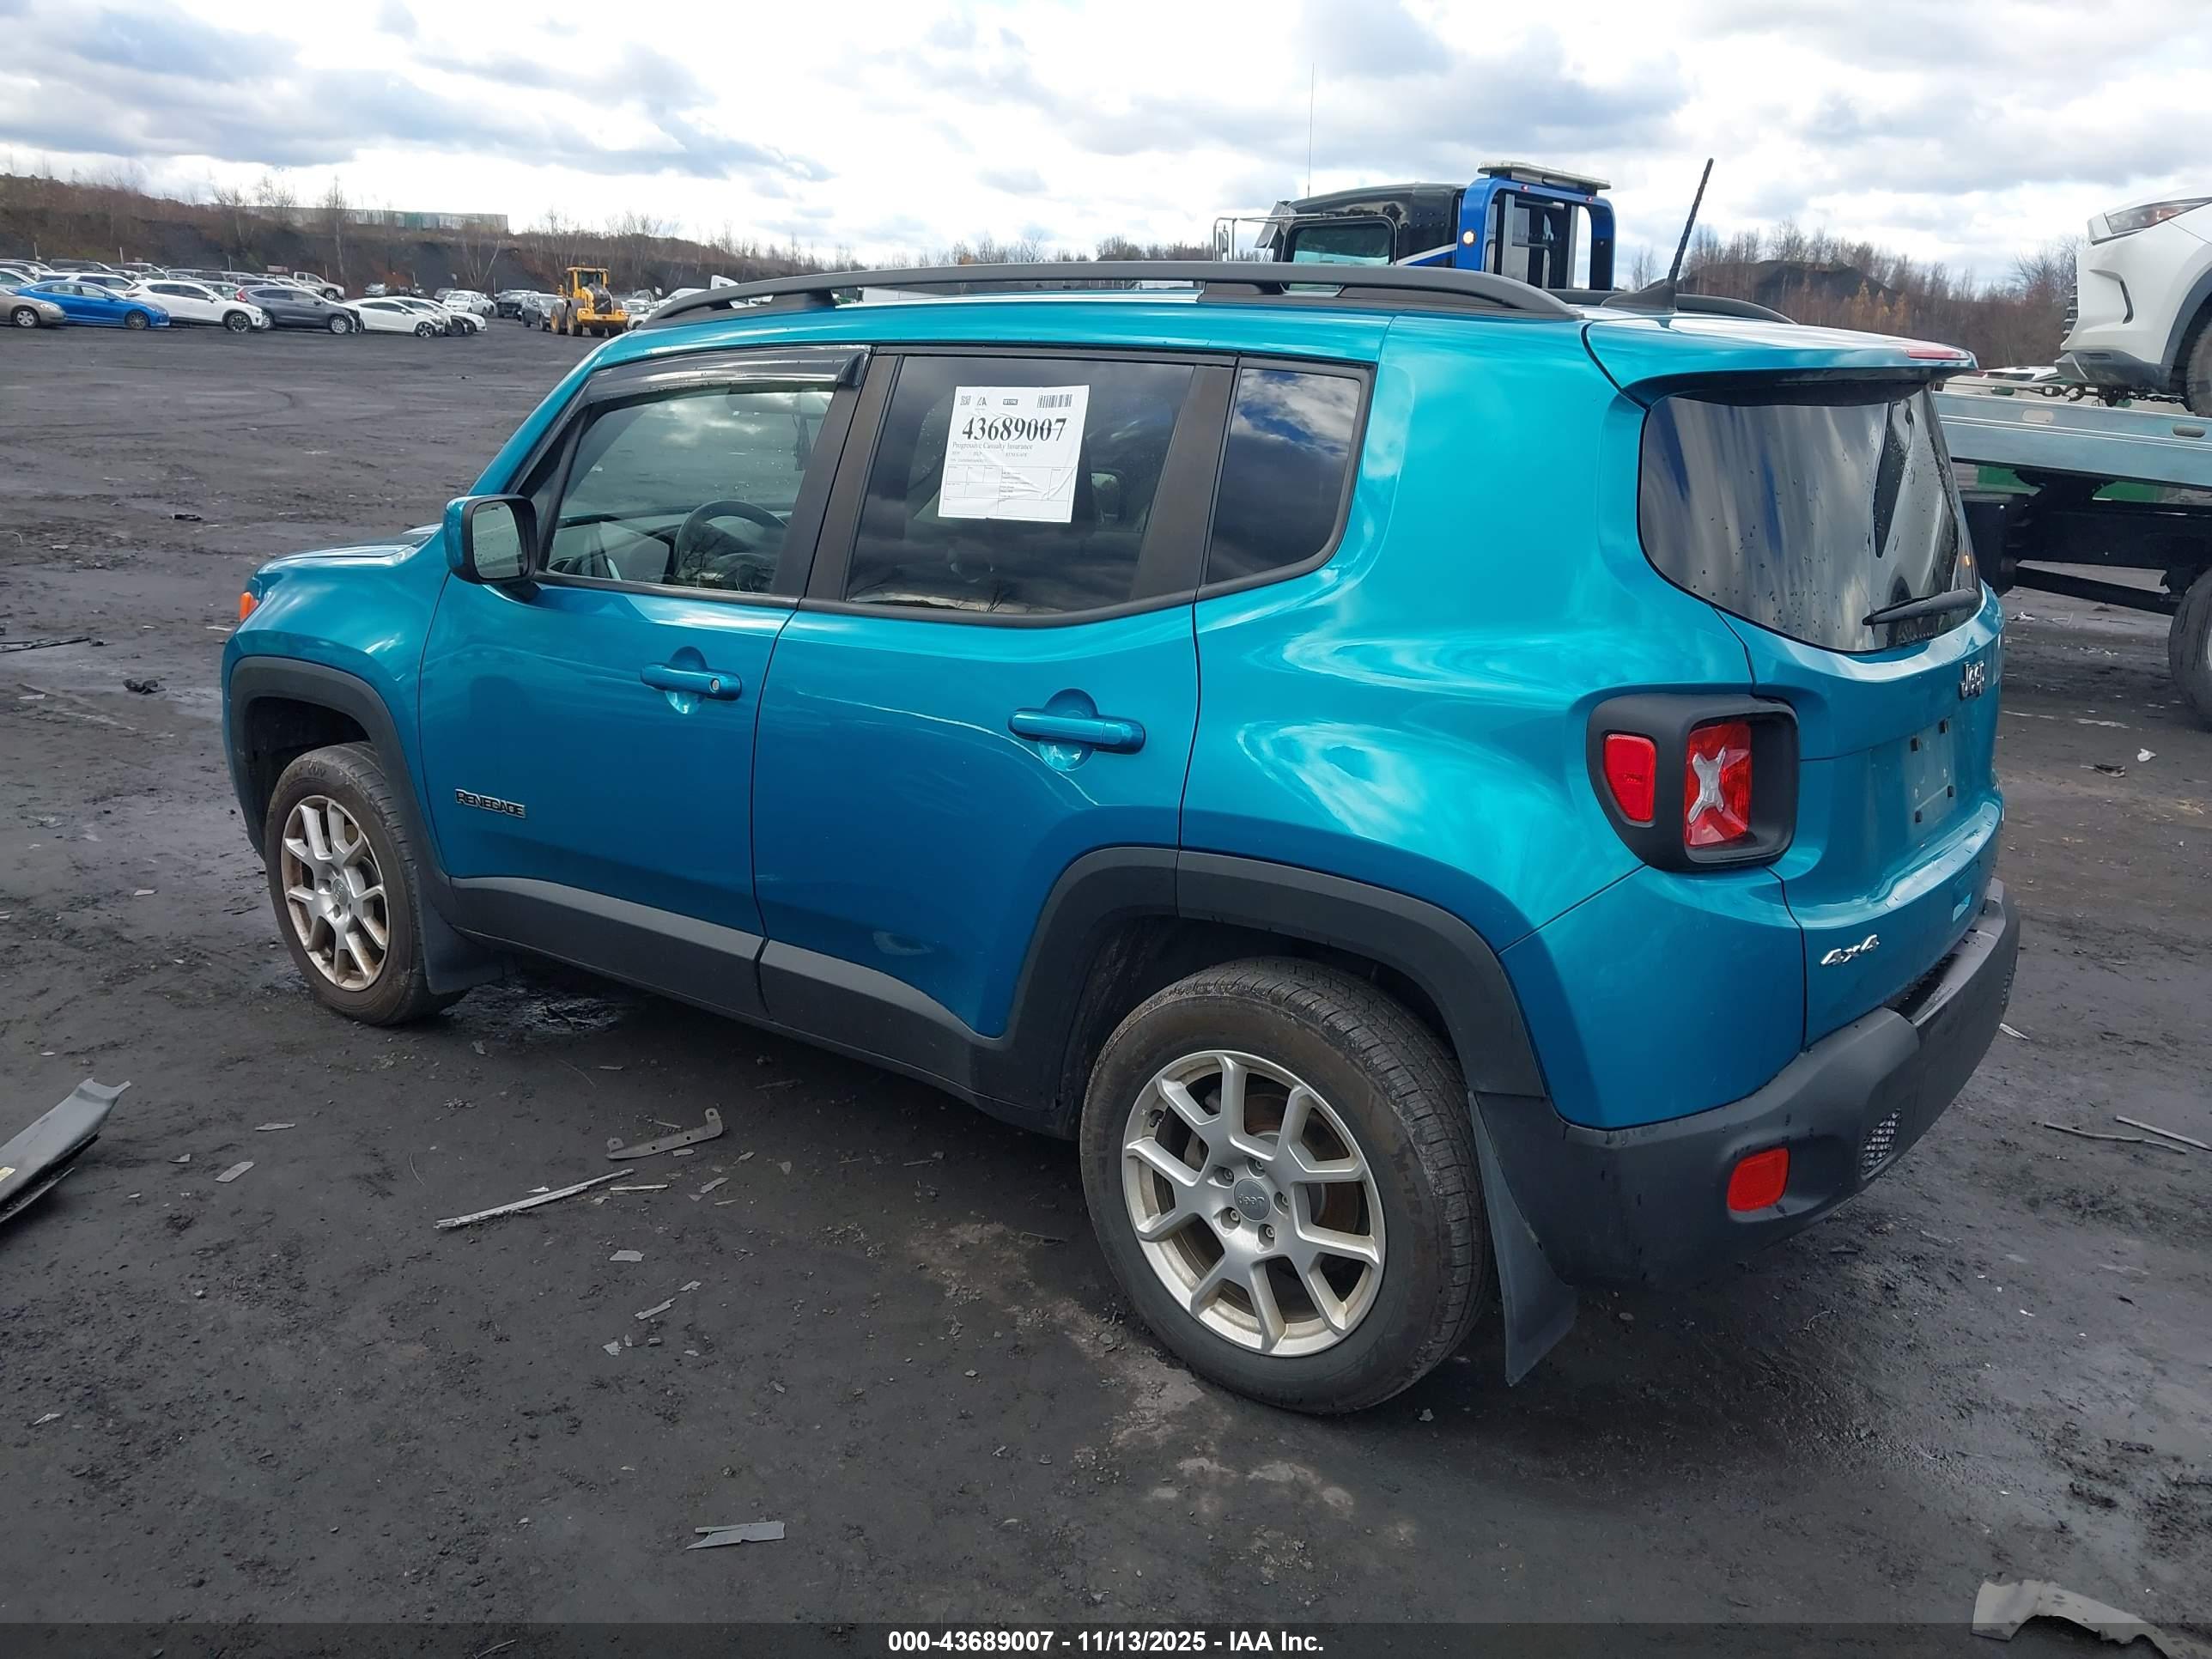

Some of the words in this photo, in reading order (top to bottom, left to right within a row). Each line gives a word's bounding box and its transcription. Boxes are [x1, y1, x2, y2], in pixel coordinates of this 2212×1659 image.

[962, 416, 1067, 441] 43689007
[952, 441, 982, 450] Progressive
[983, 441, 1006, 452] Casualty
[454, 788, 526, 818] RENEGADE
[1820, 933, 1880, 966] 4x4
